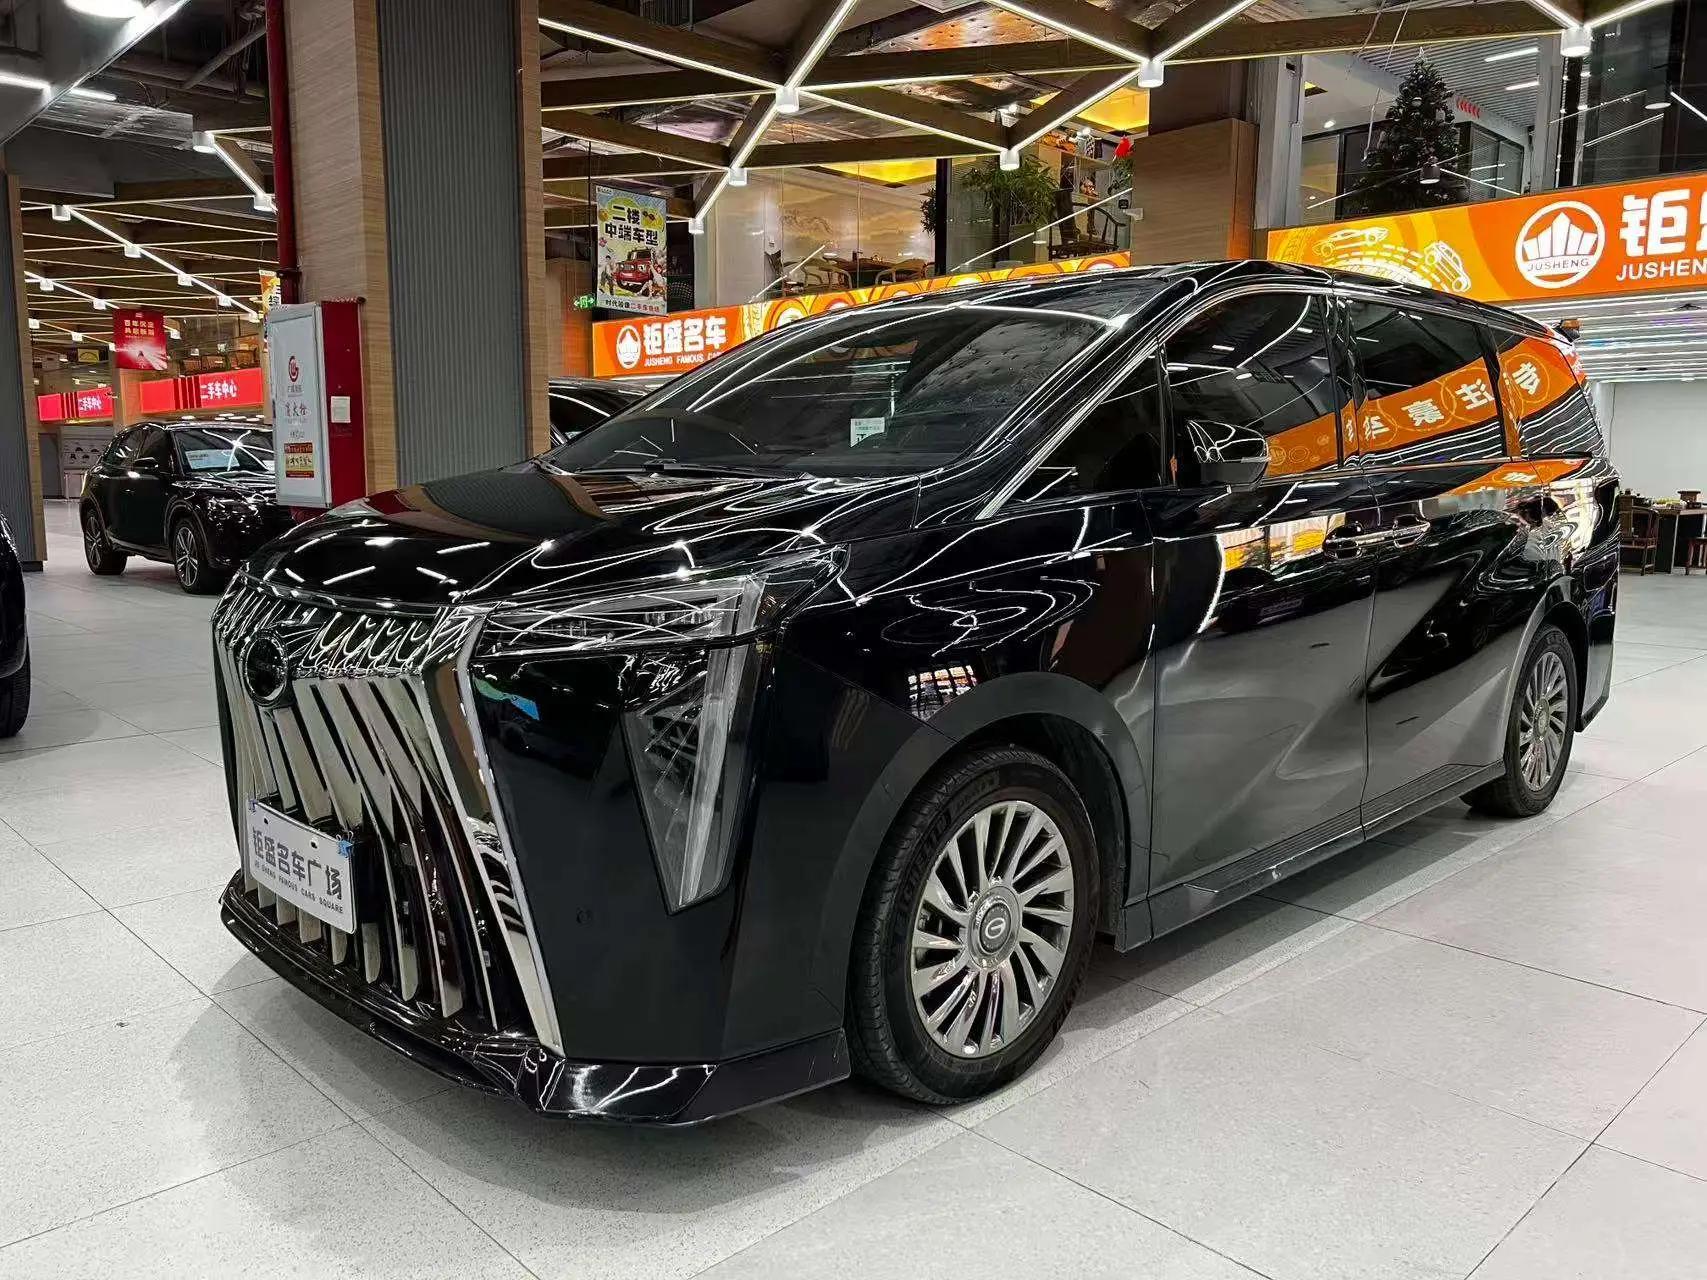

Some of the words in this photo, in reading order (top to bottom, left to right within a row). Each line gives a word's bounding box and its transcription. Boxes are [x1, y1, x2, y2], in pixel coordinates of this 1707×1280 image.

[612, 205, 641, 226] 二楼
[1619, 189, 1707, 257] 钜
[605, 222, 659, 246] 中端车型
[1527, 257, 1590, 272] JUSHENG
[643, 316, 727, 355] 钜盛名车
[644, 356, 673, 367] JUSHENG
[676, 353, 704, 364] FAMOUS
[200, 378, 238, 400] 二手车中心
[252, 826, 342, 900] 钜盛名车广场
[279, 875, 298, 892] FAMOUS
[301, 888, 316, 901] CARS
[319, 896, 344, 914] SQUARE
